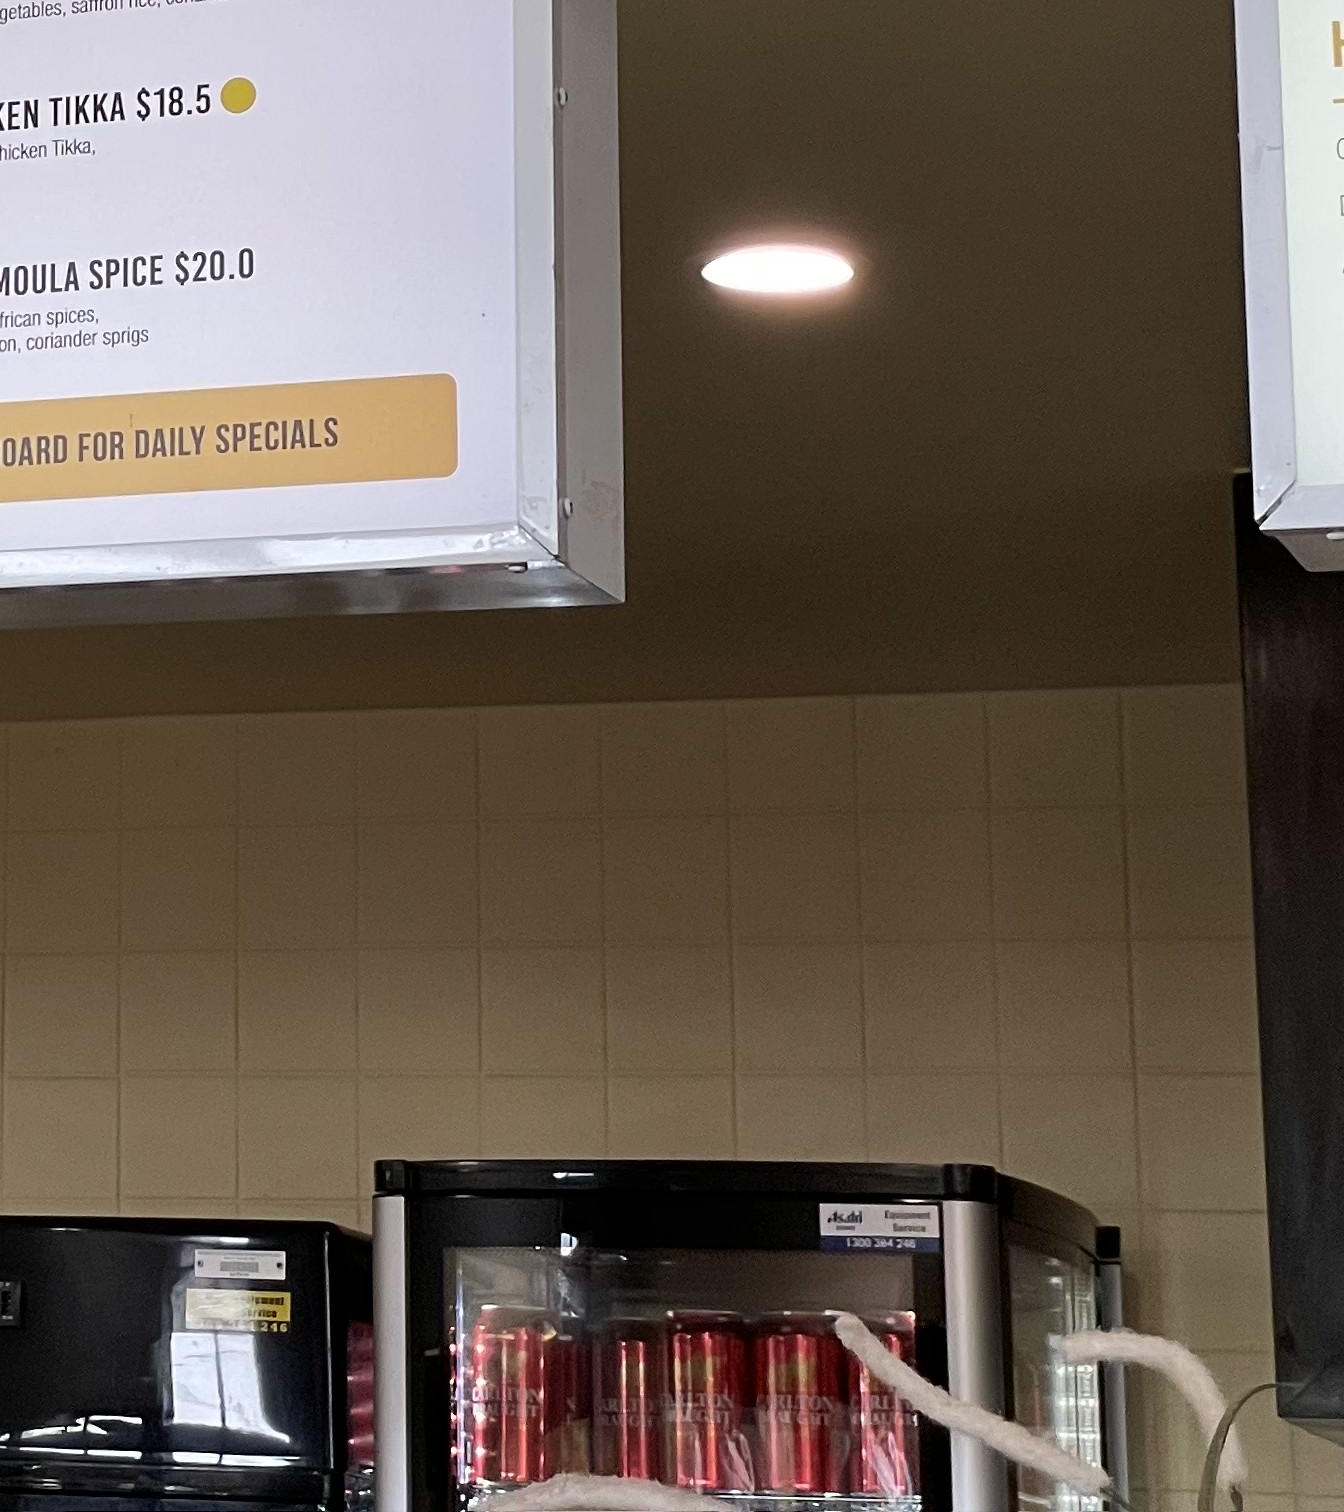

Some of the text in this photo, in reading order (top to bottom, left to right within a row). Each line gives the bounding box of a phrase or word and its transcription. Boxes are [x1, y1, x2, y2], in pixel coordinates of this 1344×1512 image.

[48, 91, 126, 127] TIKKA
[136, 83, 211, 122] $18.5
[88, 254, 164, 290] SPICE
[174, 247, 254, 286] $20.0
[46, 308, 99, 334] spices,
[78, 431, 124, 463] FOR
[134, 424, 206, 460] DAILY
[215, 416, 339, 454] SPECIALS
